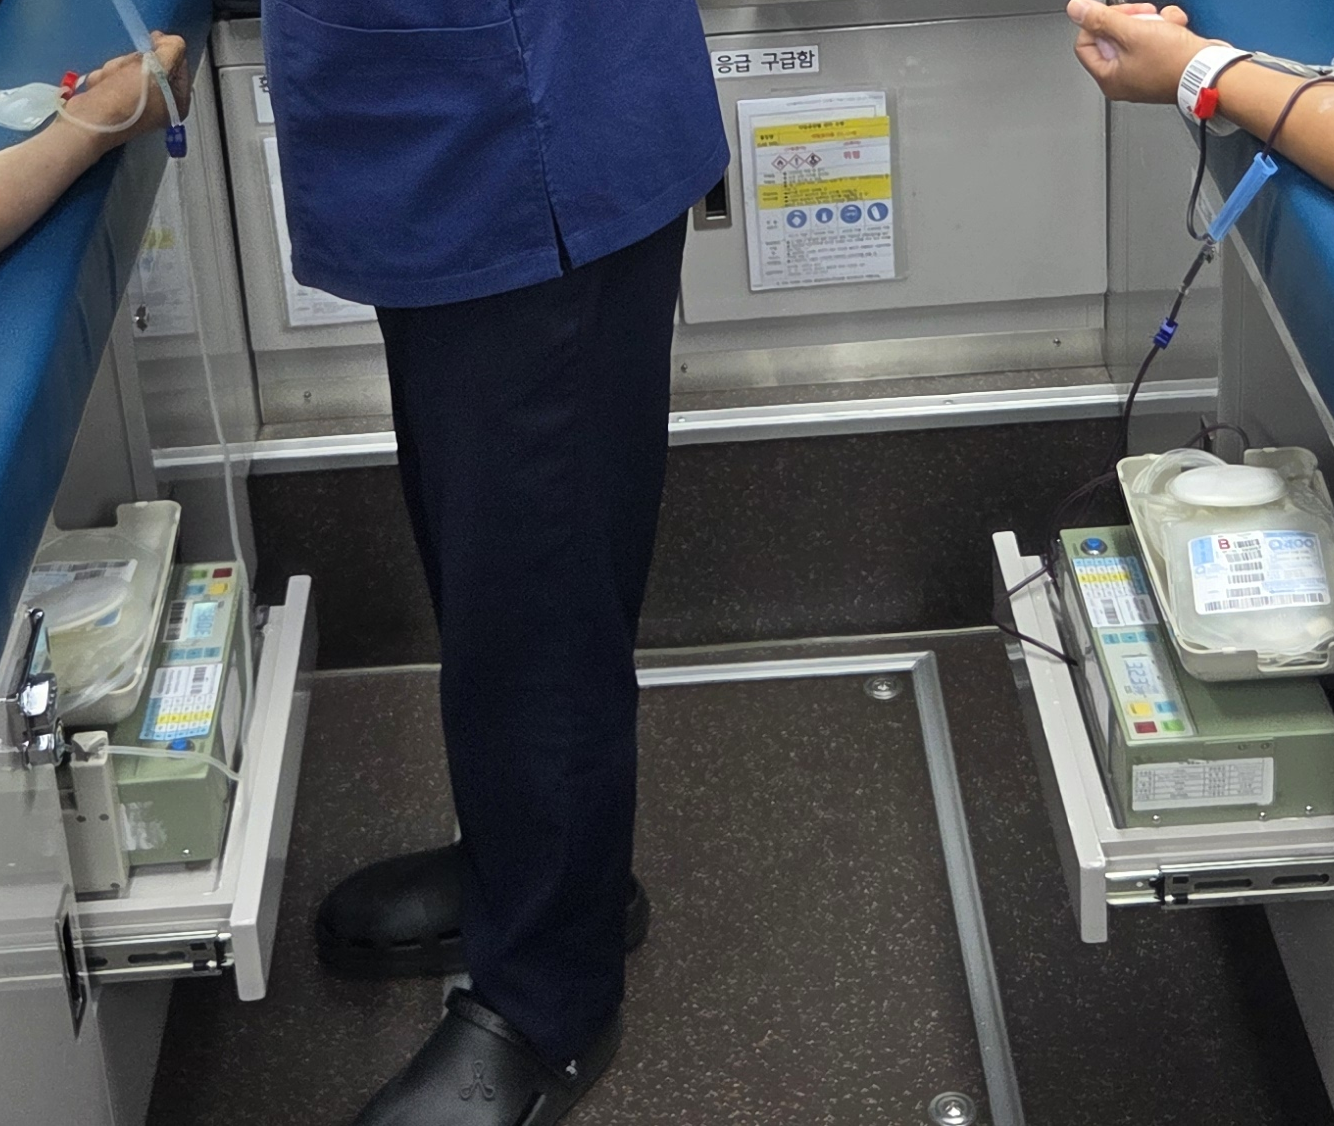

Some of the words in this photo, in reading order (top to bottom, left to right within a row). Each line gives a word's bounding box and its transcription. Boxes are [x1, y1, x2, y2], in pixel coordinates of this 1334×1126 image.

[716, 54, 752, 74] 응급
[761, 50, 815, 72] 구급함
[1218, 538, 1231, 550] B
